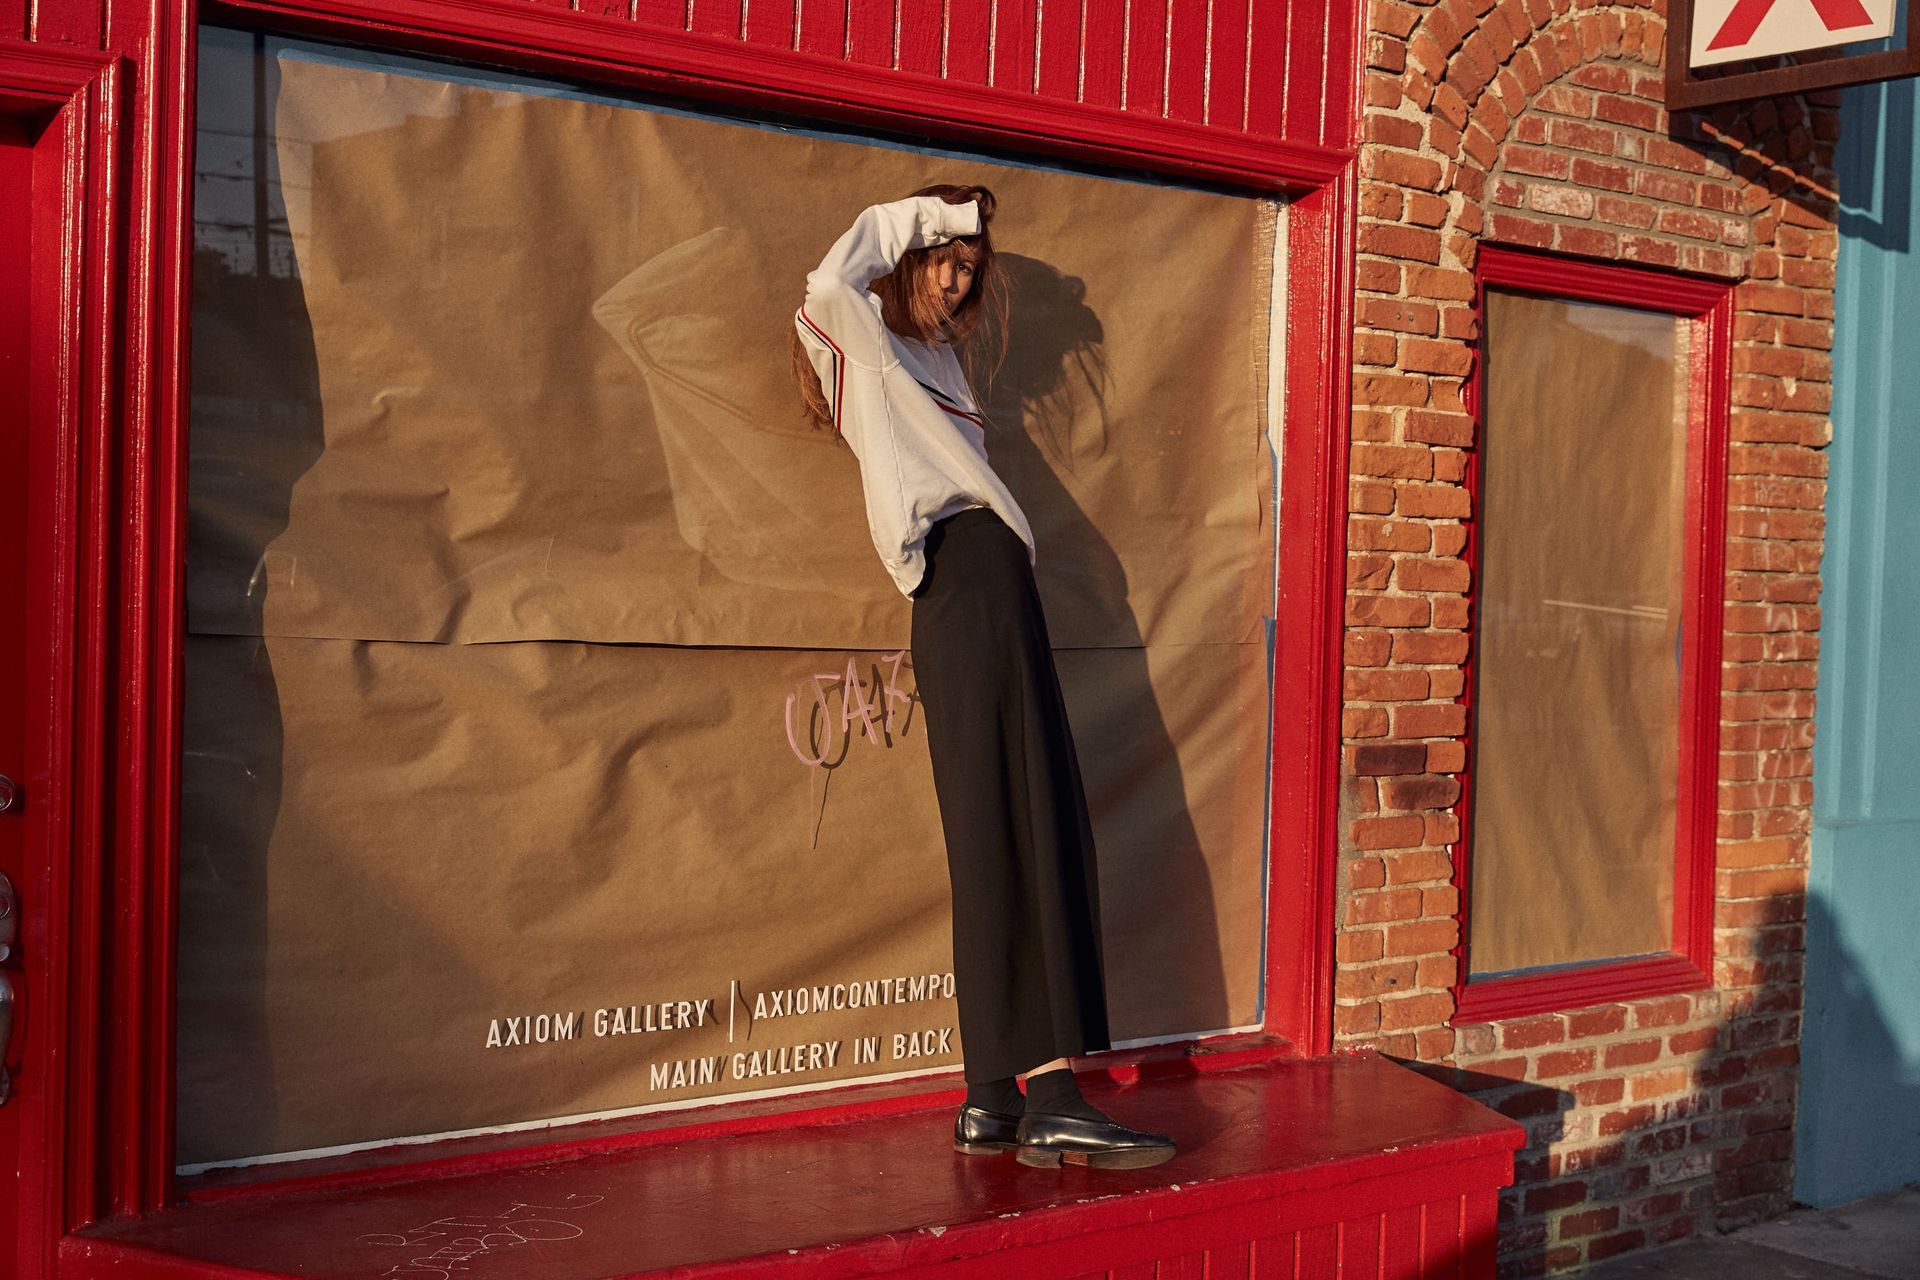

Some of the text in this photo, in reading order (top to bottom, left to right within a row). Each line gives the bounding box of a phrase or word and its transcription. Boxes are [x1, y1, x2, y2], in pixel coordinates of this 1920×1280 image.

[486, 972, 955, 1048] AXIOM GALLERY AXIOMCONTEMPO
[650, 1027, 951, 1091] MAIN GALLERY IN BACK
